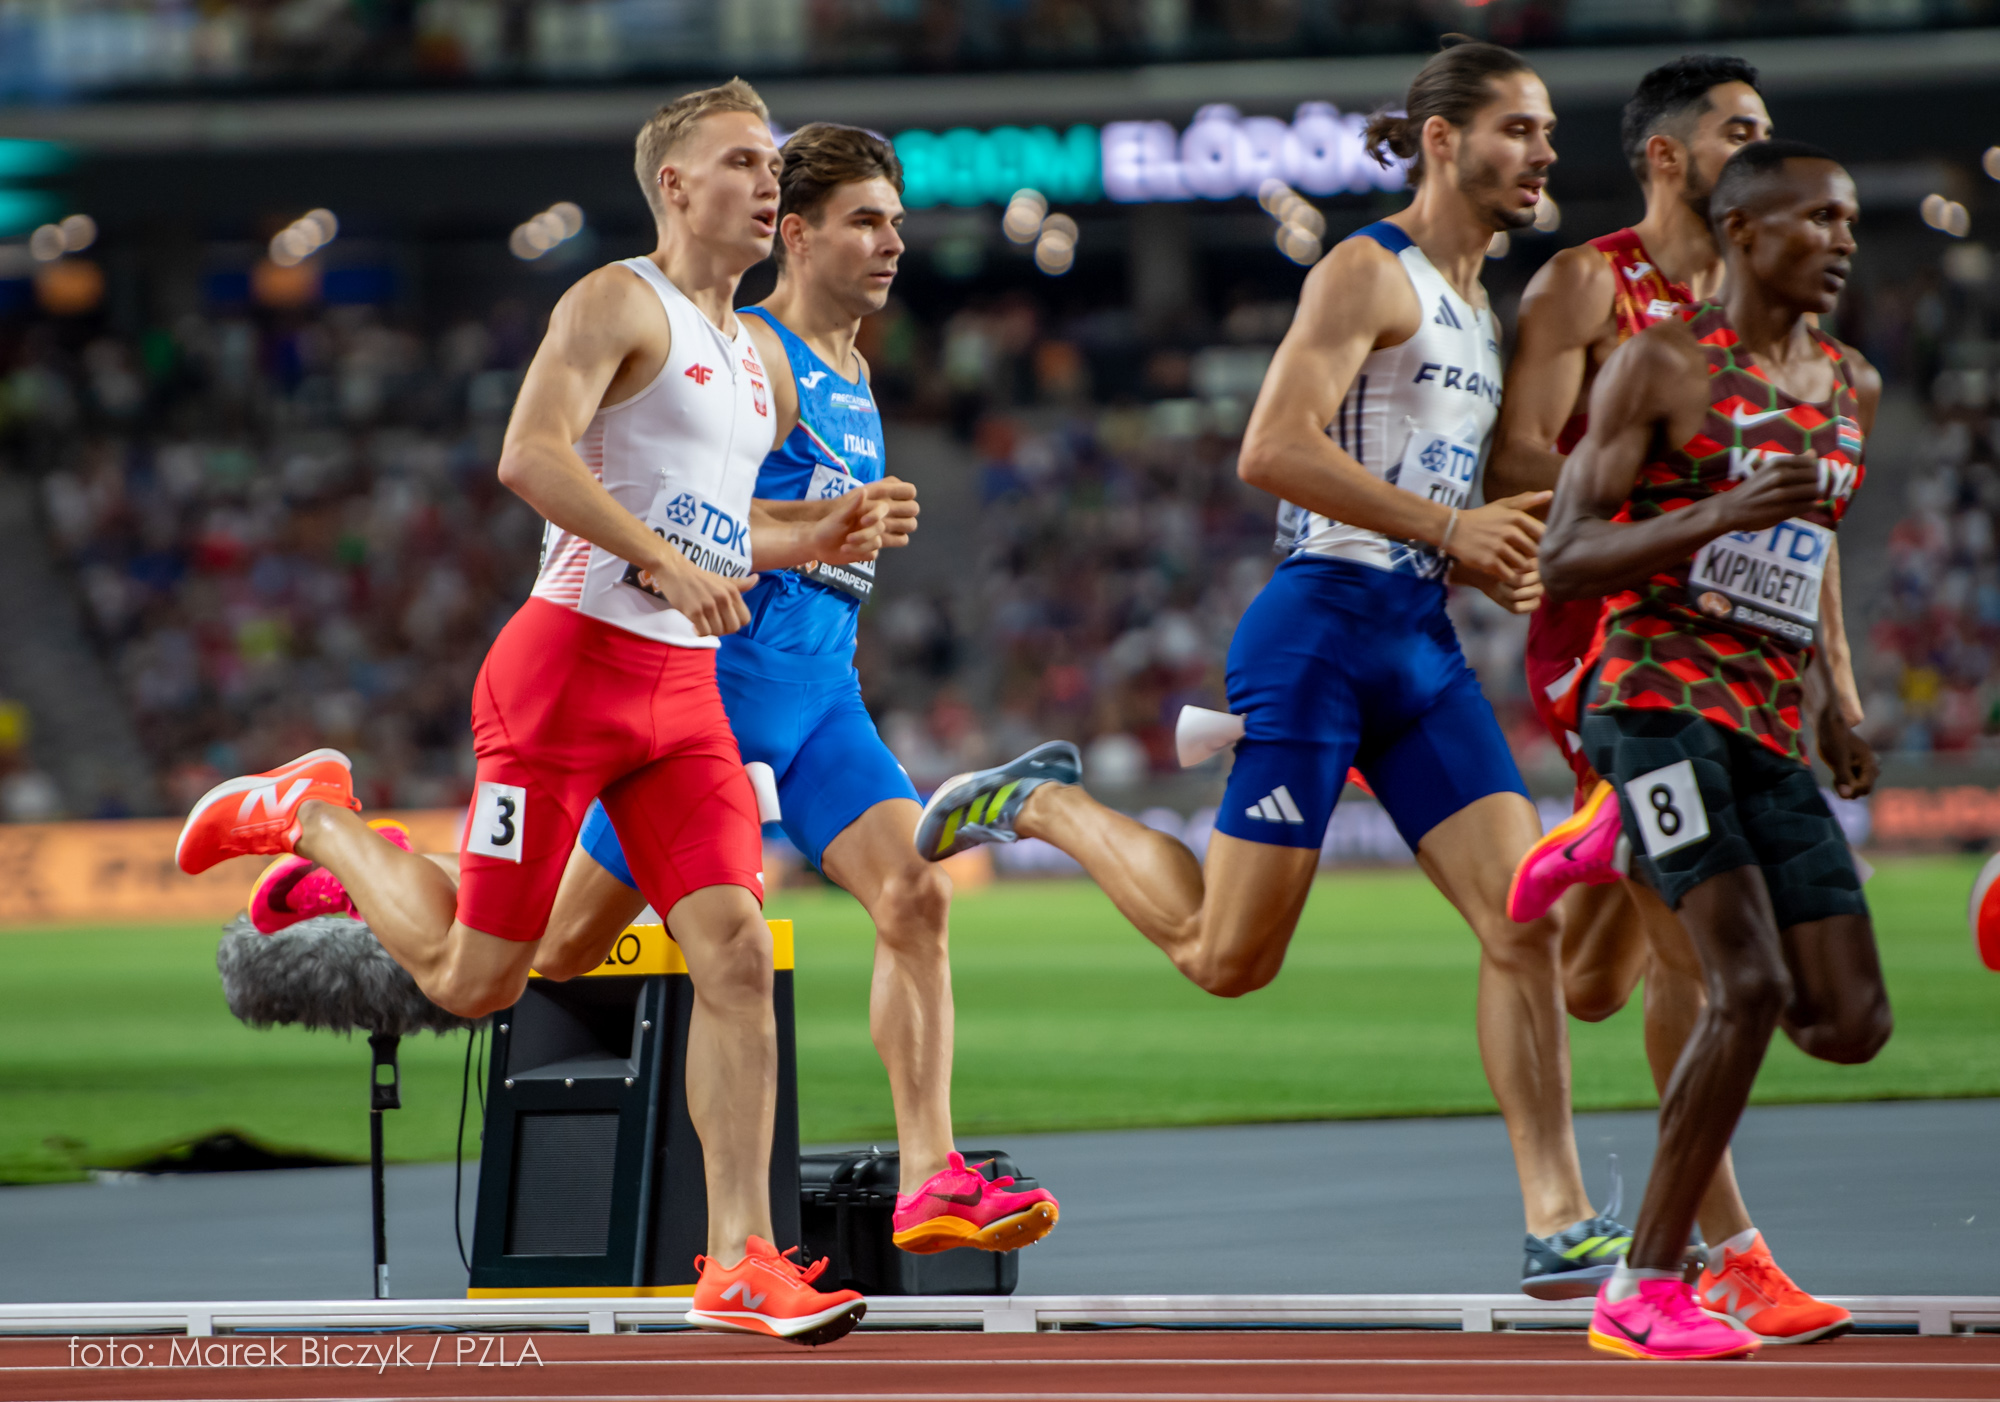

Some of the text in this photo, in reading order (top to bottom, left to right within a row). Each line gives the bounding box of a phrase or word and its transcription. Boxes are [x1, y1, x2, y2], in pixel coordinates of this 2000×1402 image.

[684, 362, 713, 385] 4F
[844, 433, 877, 459] ITALIA
[700, 501, 747, 557] TDK
[819, 563, 873, 594] BUDAPEST
[491, 796, 515, 846] 3
[1650, 783, 1683, 836] 8
[605, 933, 641, 966] O
